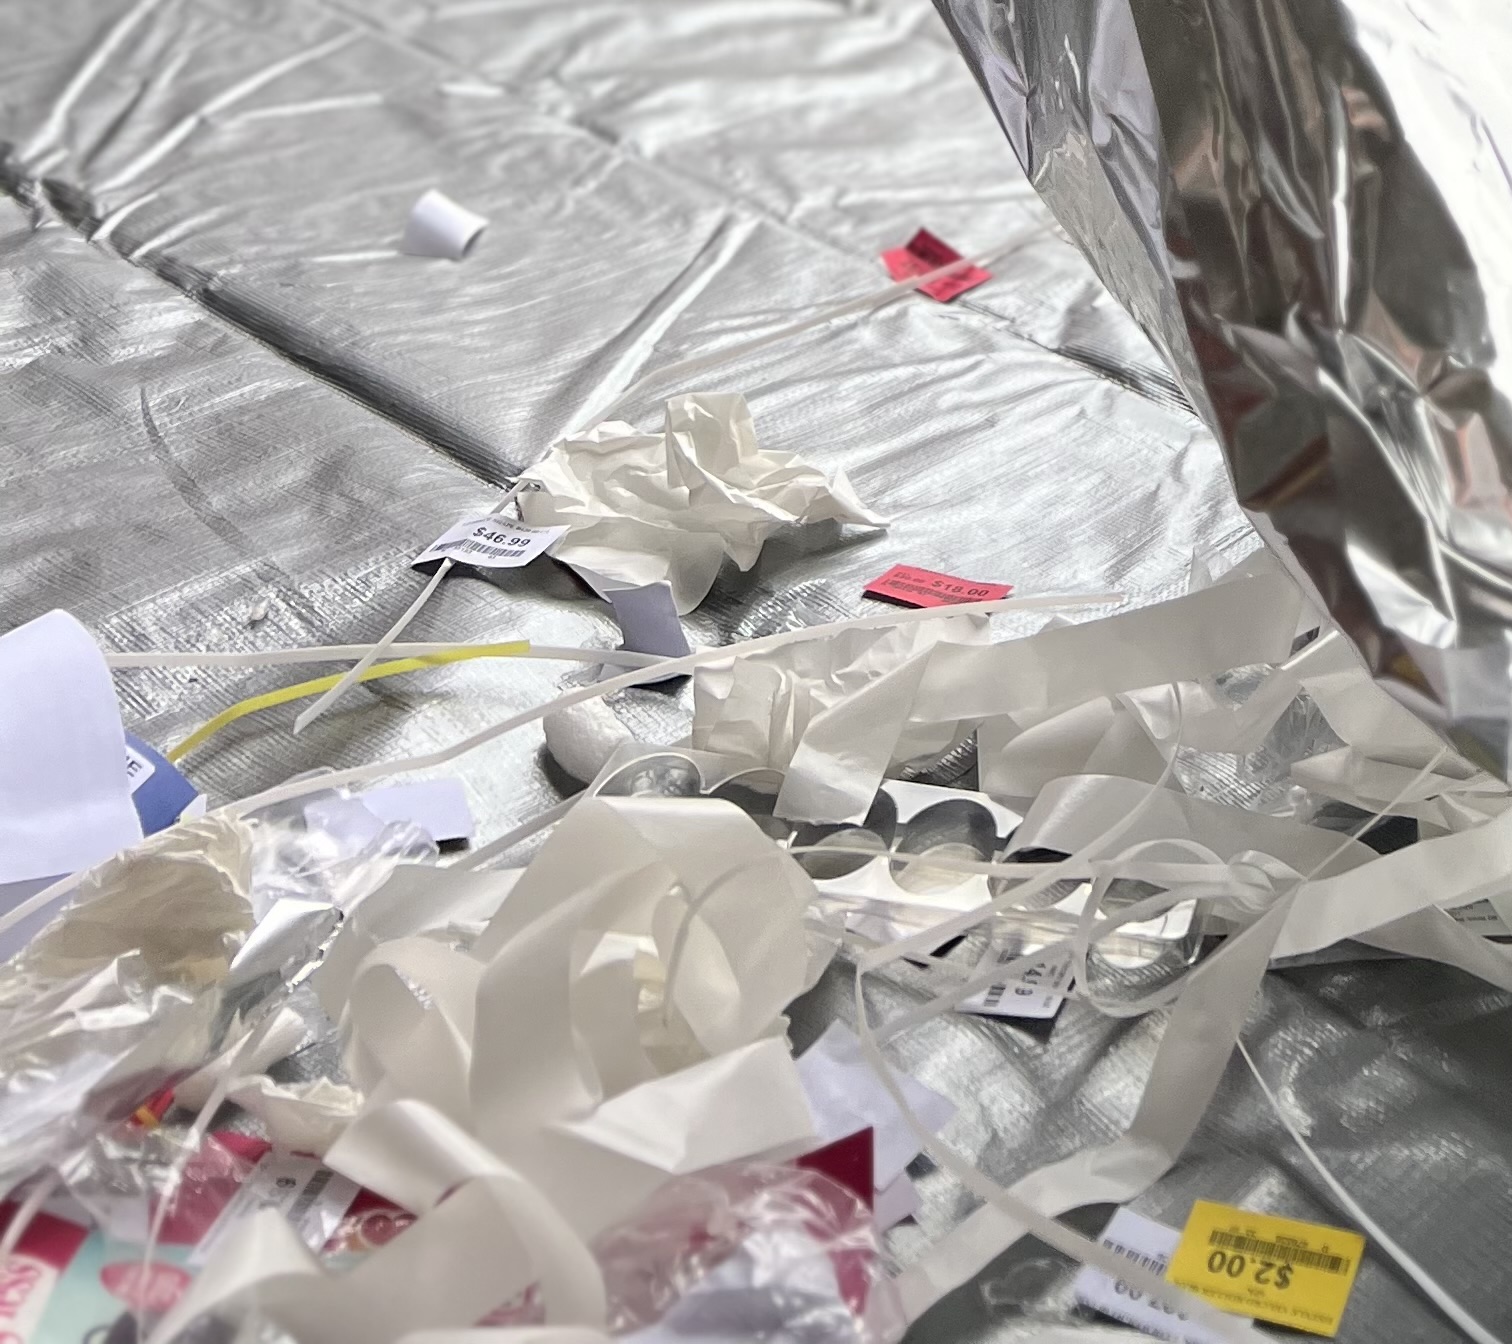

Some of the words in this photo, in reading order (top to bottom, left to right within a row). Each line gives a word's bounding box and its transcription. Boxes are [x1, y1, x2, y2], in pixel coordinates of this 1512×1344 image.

[473, 527, 531, 546] $46.99
[932, 581, 989, 597] $18.00
[1207, 1250, 1295, 1290] $2.00
